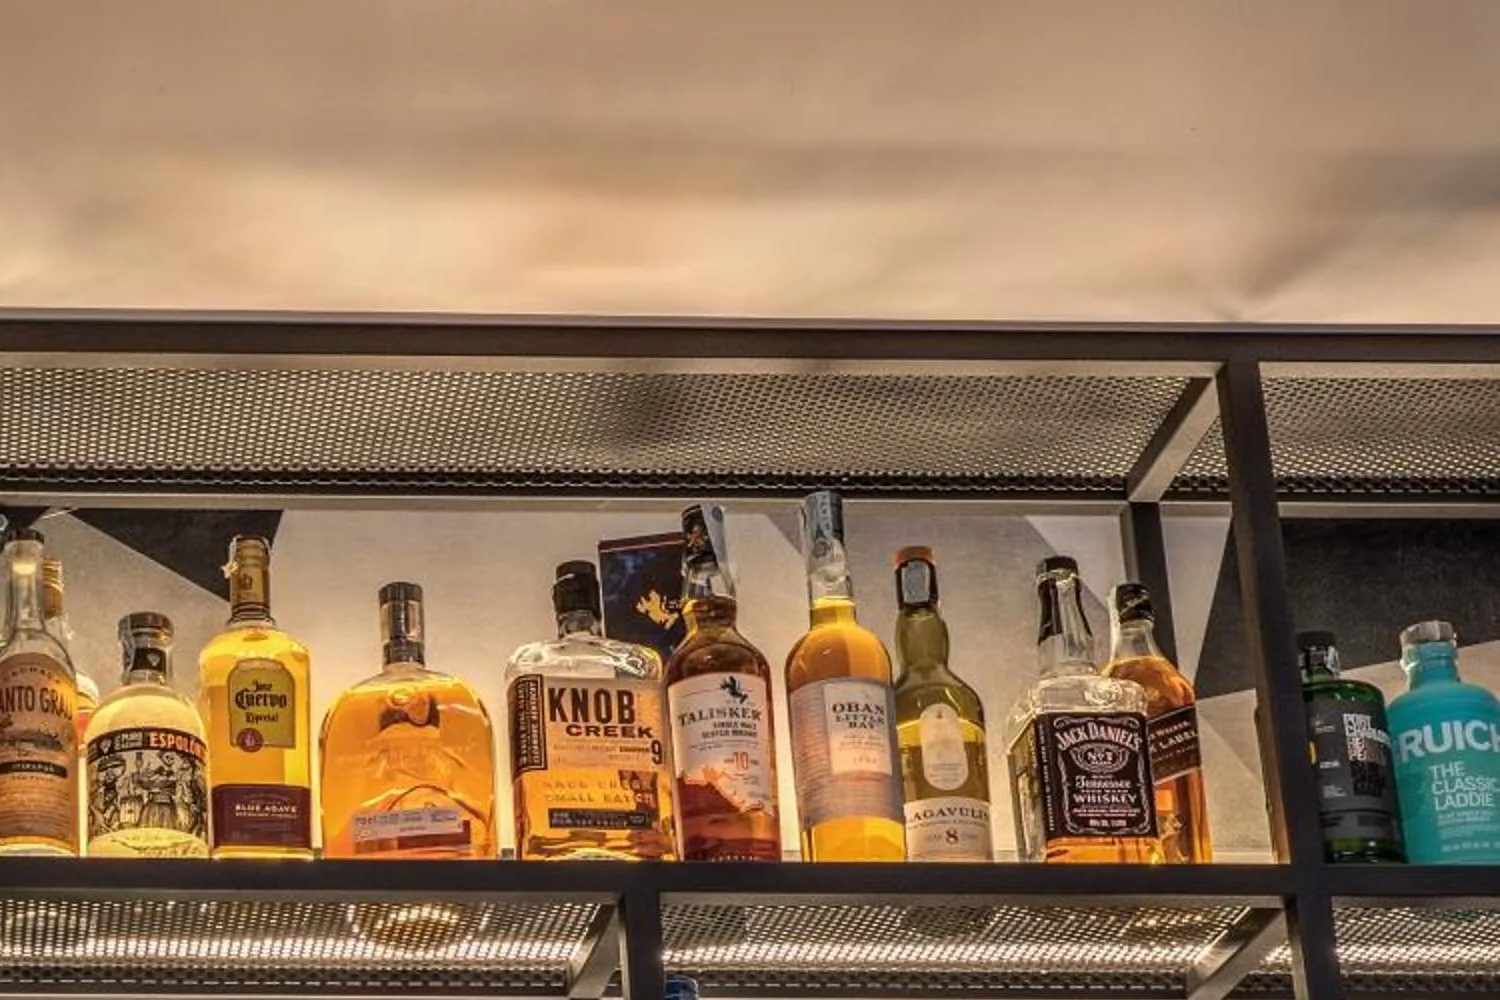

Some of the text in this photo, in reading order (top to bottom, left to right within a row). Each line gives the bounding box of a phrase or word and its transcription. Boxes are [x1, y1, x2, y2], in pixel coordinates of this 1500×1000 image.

[235, 690, 288, 709] Cuervo
[548, 687, 636, 724] KNOB
[678, 706, 762, 727] TALISKER
[832, 702, 886, 717] OBAN
[565, 723, 653, 739] CREEK
[848, 720, 877, 730] BAY
[1054, 720, 1144, 753] JACK DANIEL'S
[651, 739, 663, 765] 9
[1428, 760, 1466, 778] THE
[1073, 794, 1138, 805] WHISKEY
[1434, 794, 1496, 811] LADDIE
[944, 827, 959, 845] 8
